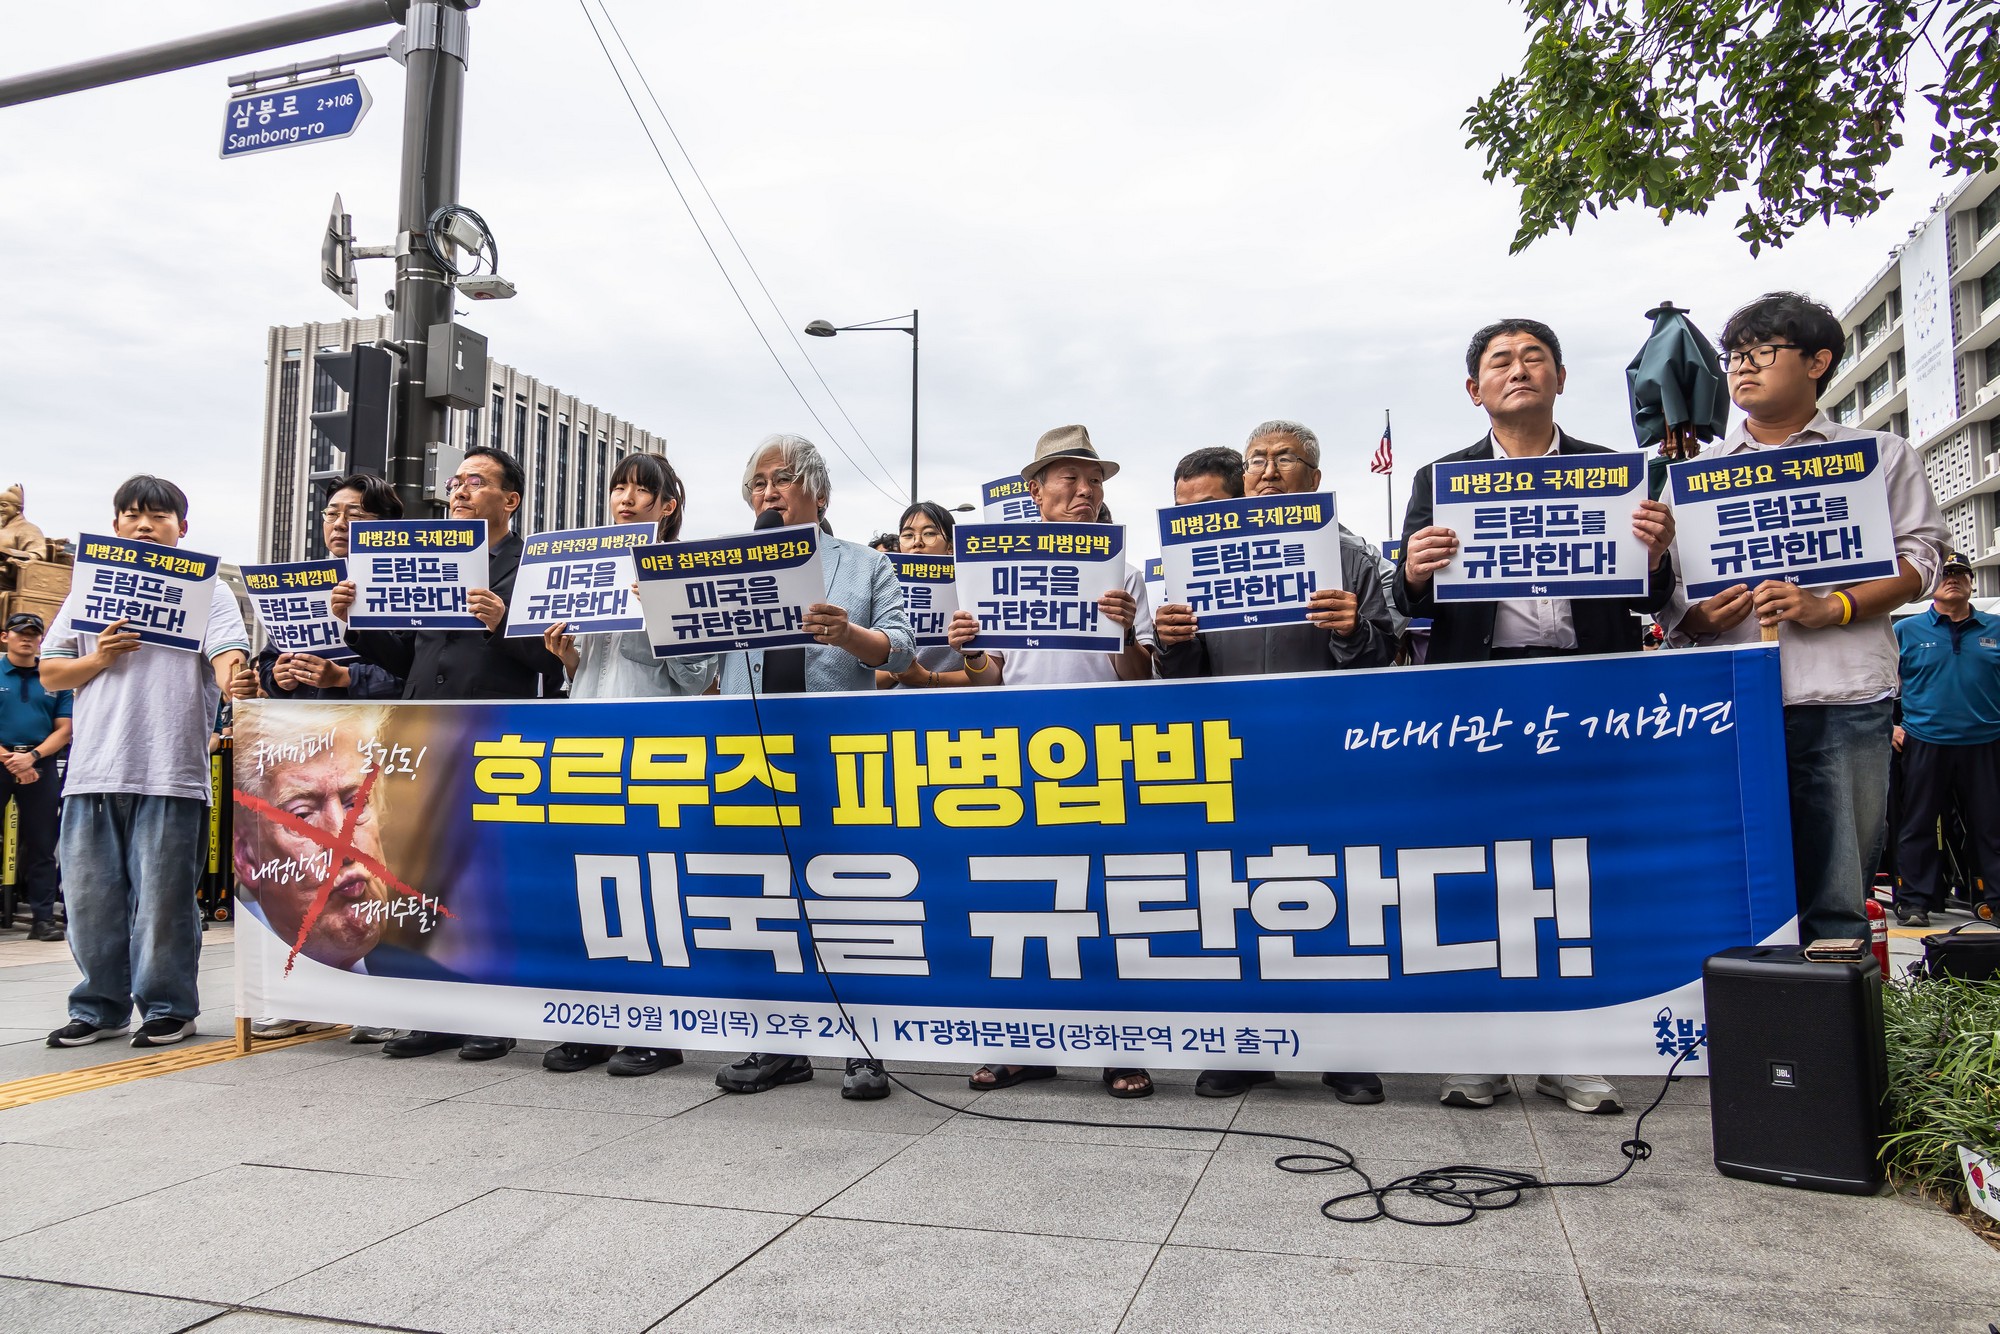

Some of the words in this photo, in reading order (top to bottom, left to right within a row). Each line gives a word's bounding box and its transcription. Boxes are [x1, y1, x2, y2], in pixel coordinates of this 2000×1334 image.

[232, 95, 300, 129] 삼봉로
[228, 121, 324, 150] Sambong-ro
[1450, 471, 1536, 495] 파병강요
[1541, 465, 1629, 491] 국제깡패
[1686, 464, 1776, 493] 파병강요
[1781, 451, 1865, 480] 국제깡패
[1170, 512, 1241, 537] 파병강요
[1246, 504, 1322, 527] 국제깡패
[1473, 504, 1606, 540] 트럼프를
[1716, 492, 1849, 537] 트럼프를
[358, 530, 411, 547] 파병강요
[414, 529, 474, 547] 국제깡패
[527, 542, 548, 556] 이란
[551, 537, 598, 555] 침략전쟁
[601, 533, 648, 549] 파병강요
[966, 535, 1032, 554] 호르무즈
[1037, 534, 1111, 555] 파병압박
[1710, 525, 1864, 576] 규탄한다!
[85, 543, 138, 564] 파병강요
[142, 551, 207, 577] 국제깡패
[372, 557, 459, 583] 트럼프를
[641, 555, 673, 571] 이란
[677, 548, 743, 569] 침략전쟁
[747, 540, 812, 562] 파병강요
[901, 563, 955, 579] 파병압박
[1191, 539, 1305, 577] 트럼프를
[1463, 541, 1616, 579] 규탄한다!
[92, 569, 184, 605] 트럼프를
[281, 569, 338, 587] 국제깡패
[546, 561, 616, 590] 미국을
[685, 575, 779, 609] 미국을
[992, 565, 1080, 596] 미국을
[1186, 570, 1317, 613] 규탄한다!
[85, 594, 186, 633] 규탄한다!
[258, 597, 328, 621] 트럼프를
[366, 586, 467, 613] 규탄한다!
[527, 589, 628, 620] 규탄한다!
[977, 600, 1098, 632] 규탄한다!
[671, 605, 803, 640] 규탄한다!
[1344, 707, 1513, 753] 미대사관
[1523, 704, 1570, 755] 앞
[1580, 692, 1735, 740] 기자회견
[252, 727, 336, 777] 국제깡패!
[357, 736, 427, 781] 날강도!
[472, 733, 801, 828] 호르무즈
[829, 718, 1244, 828] 파병압박
[211, 776, 219, 822] POLICE
[9, 804, 17, 829] ICE
[8, 838, 16, 871] LINE
[251, 849, 333, 885] 내정간섭!
[351, 893, 439, 933] 경제수탈!
[573, 851, 931, 976] 미국을
[967, 836, 1594, 981] 규탄한다!
[542, 1002, 621, 1030] 2026년
[627, 1006, 662, 1032] 9월
[669, 1009, 759, 1039] 10일(목)
[766, 1013, 813, 1039] 오후
[818, 1016, 857, 1041] 2시
[1181, 1027, 1226, 1054] 2번
[1234, 1027, 1300, 1058] 출구)
[1776, 1069, 1791, 1078] JBL
